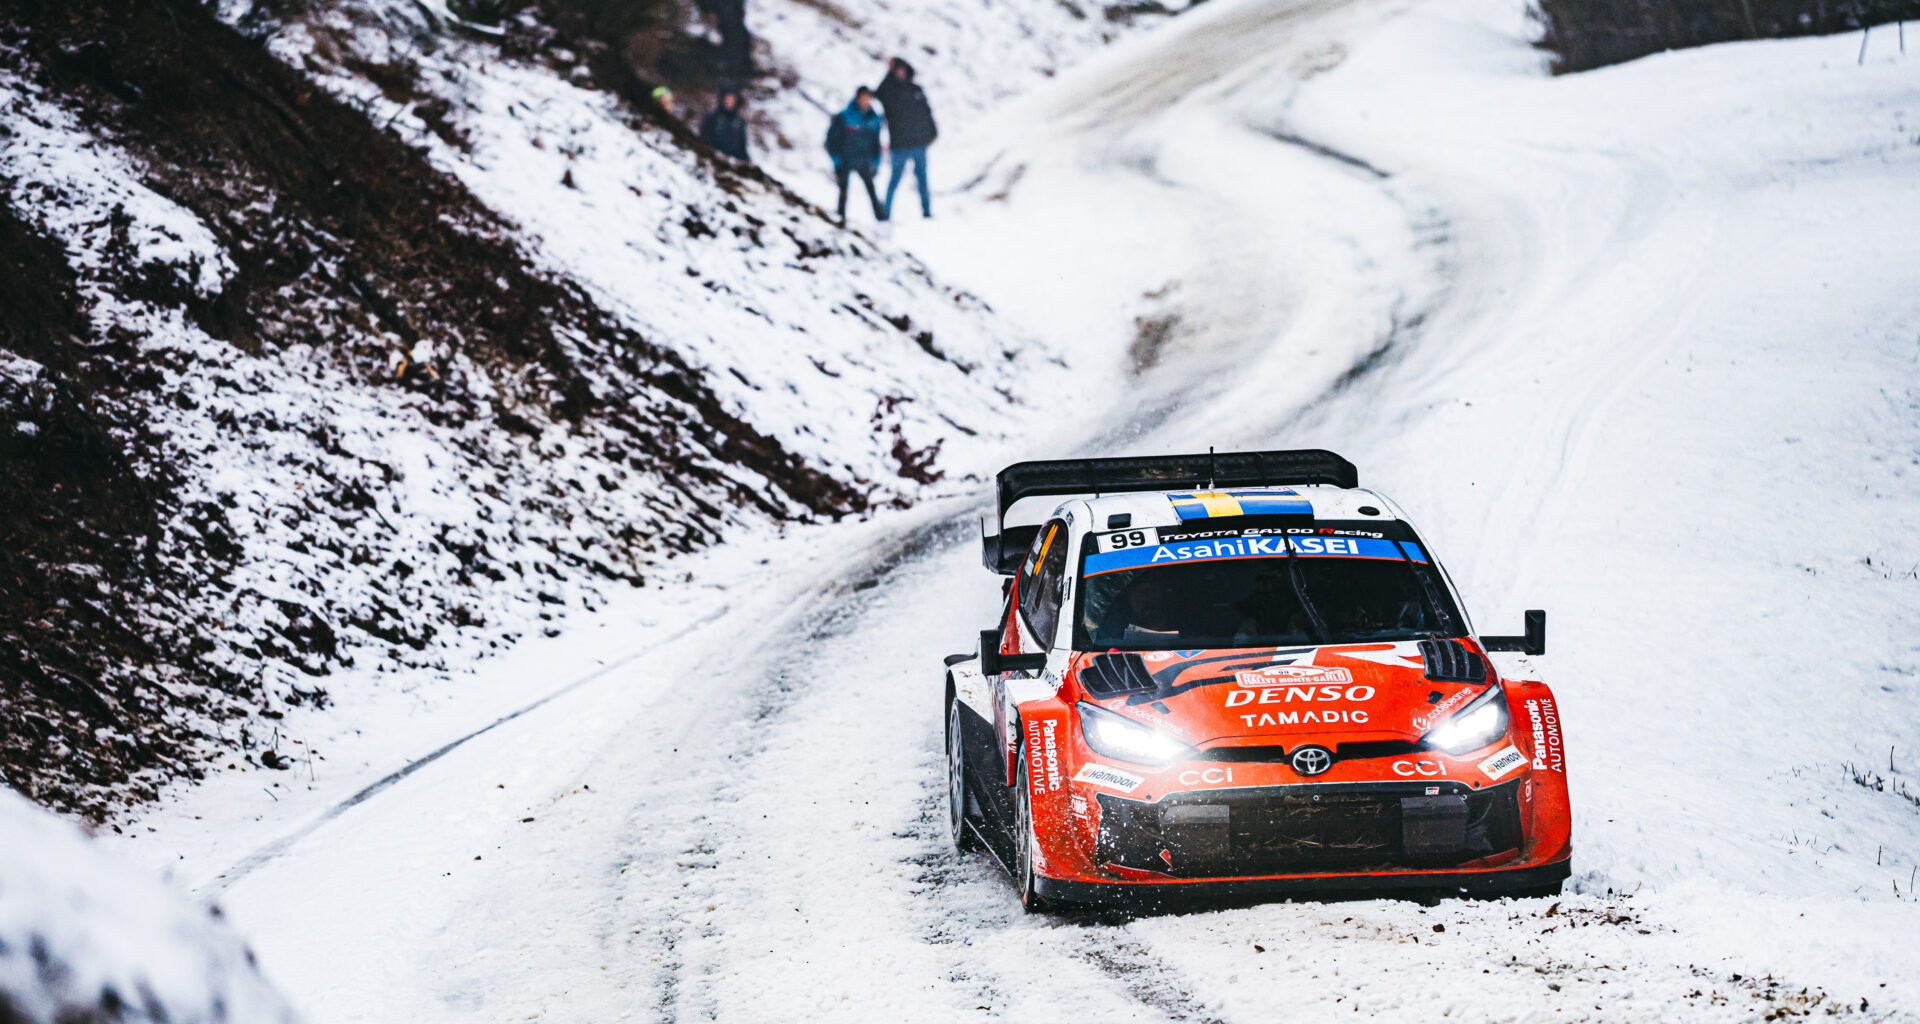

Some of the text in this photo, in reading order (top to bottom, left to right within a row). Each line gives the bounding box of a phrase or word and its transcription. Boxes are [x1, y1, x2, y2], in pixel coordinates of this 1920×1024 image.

[1111, 532, 1146, 550] 99
[1160, 530, 1238, 542] TOYOTA
[1318, 527, 1384, 539] Racing
[1244, 674, 1277, 685] RALLYE
[1224, 686, 1376, 708] DENSO
[1428, 686, 1474, 719] codebeamer
[1240, 710, 1369, 728] TAMADIC
[1523, 699, 1548, 770] Panasonic
[1540, 698, 1562, 773] AUTOMOTIVE
[1028, 720, 1046, 795] AUTOMOTIVE
[1042, 719, 1063, 792] Panasonic
